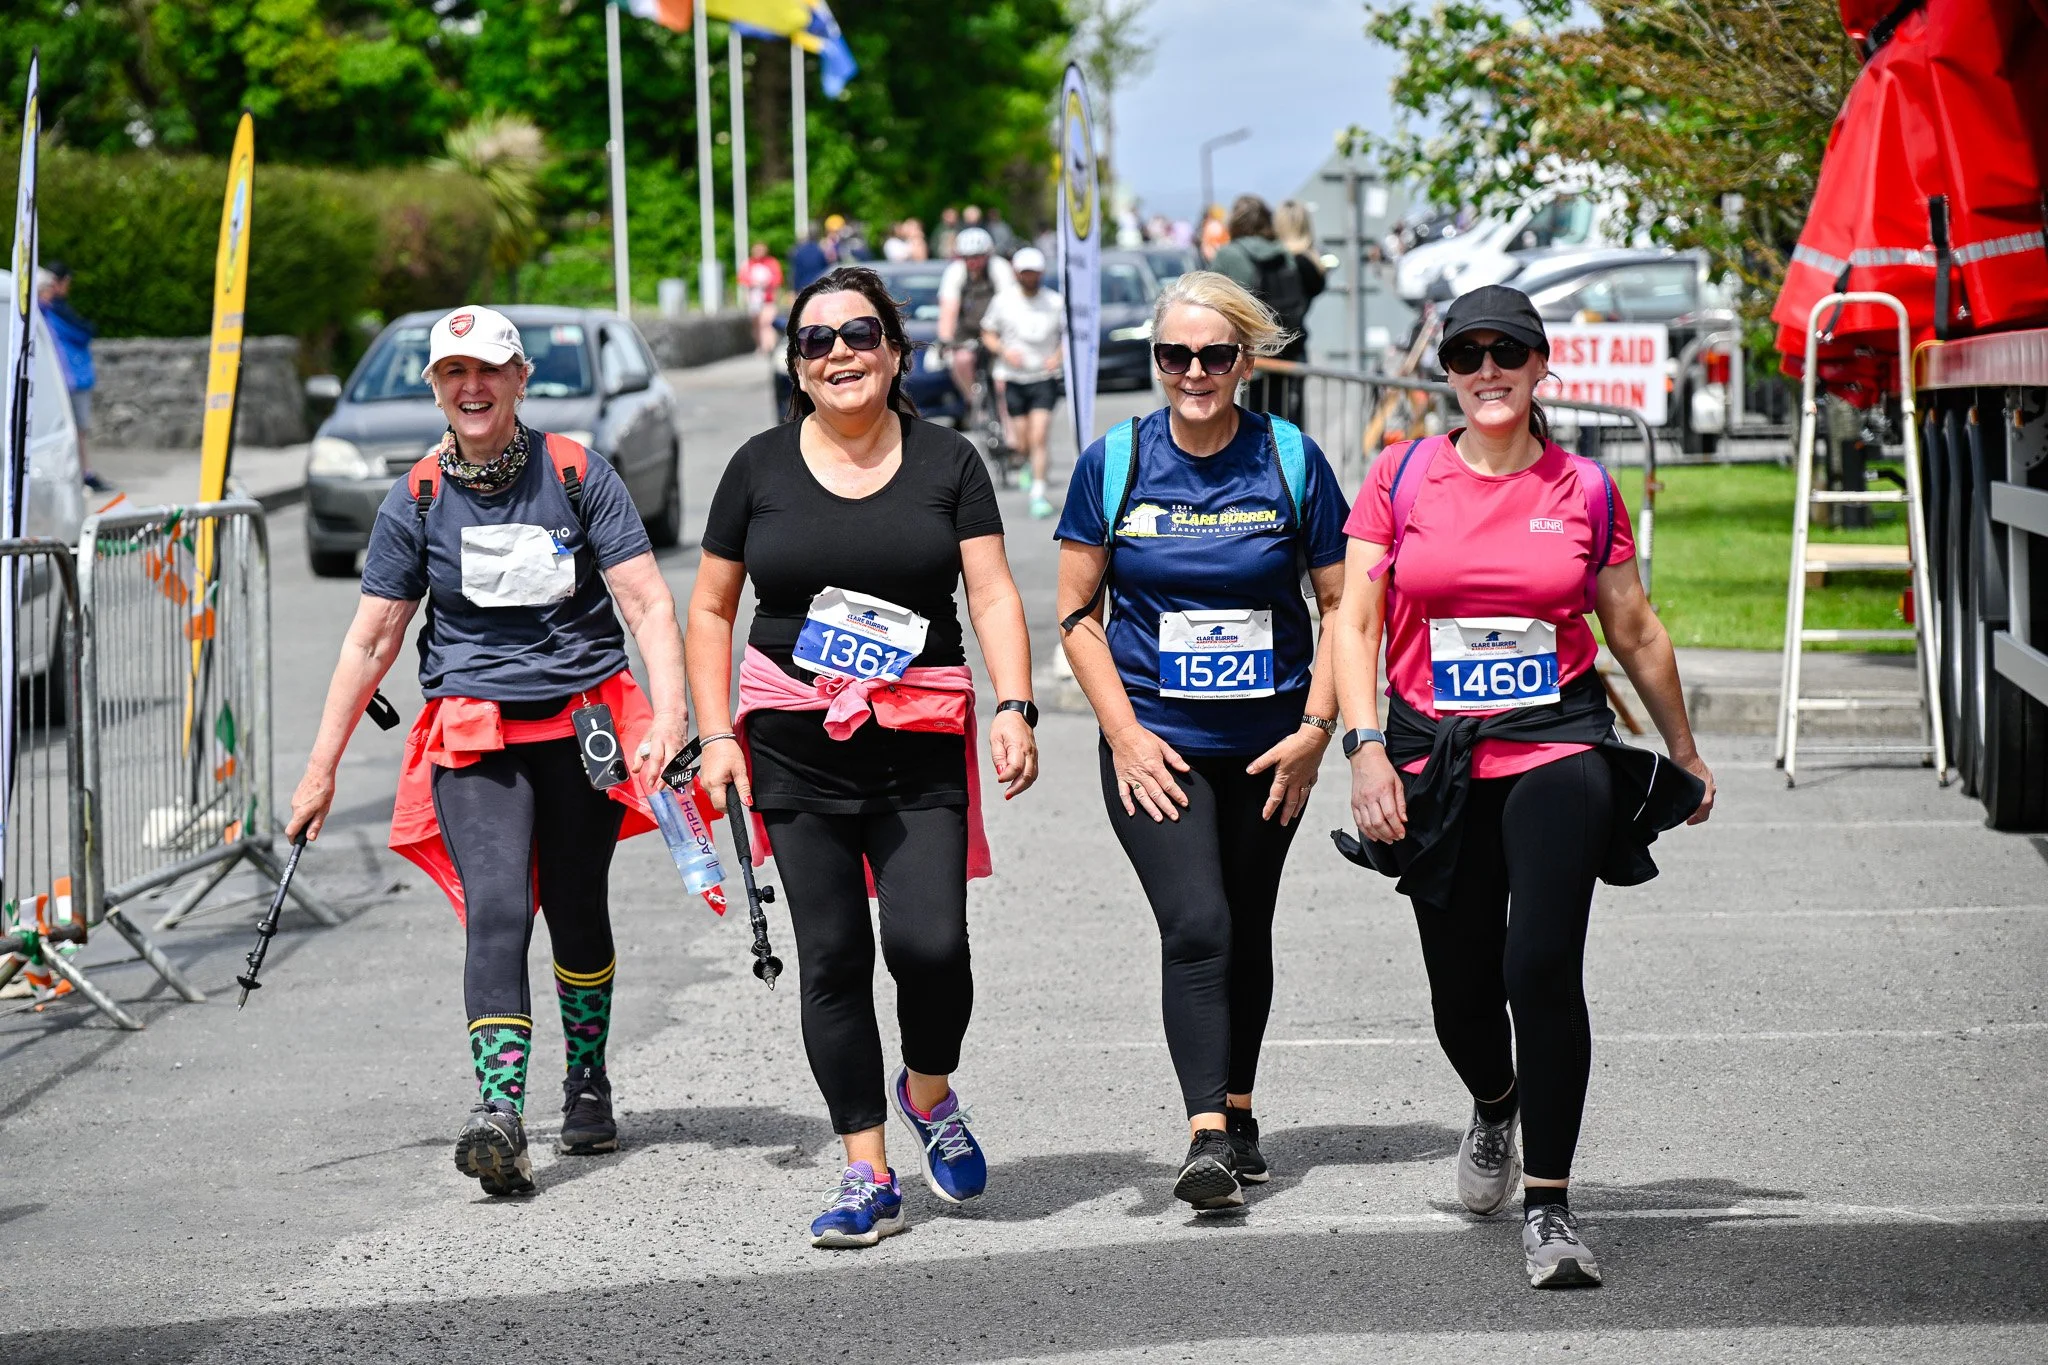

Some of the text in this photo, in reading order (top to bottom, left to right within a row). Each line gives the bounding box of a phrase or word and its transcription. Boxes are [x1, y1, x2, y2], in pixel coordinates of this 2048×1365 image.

[1552, 336, 1655, 364] RST AID
[1171, 509, 1277, 526] CLARE BURREN
[1224, 523, 1277, 532] CHALLENGE
[1532, 520, 1562, 531] RUNR
[847, 614, 865, 623] CLARE
[1491, 640, 1517, 648] BURREN
[1174, 653, 1257, 687] 1524
[1446, 658, 1542, 697] 1460
